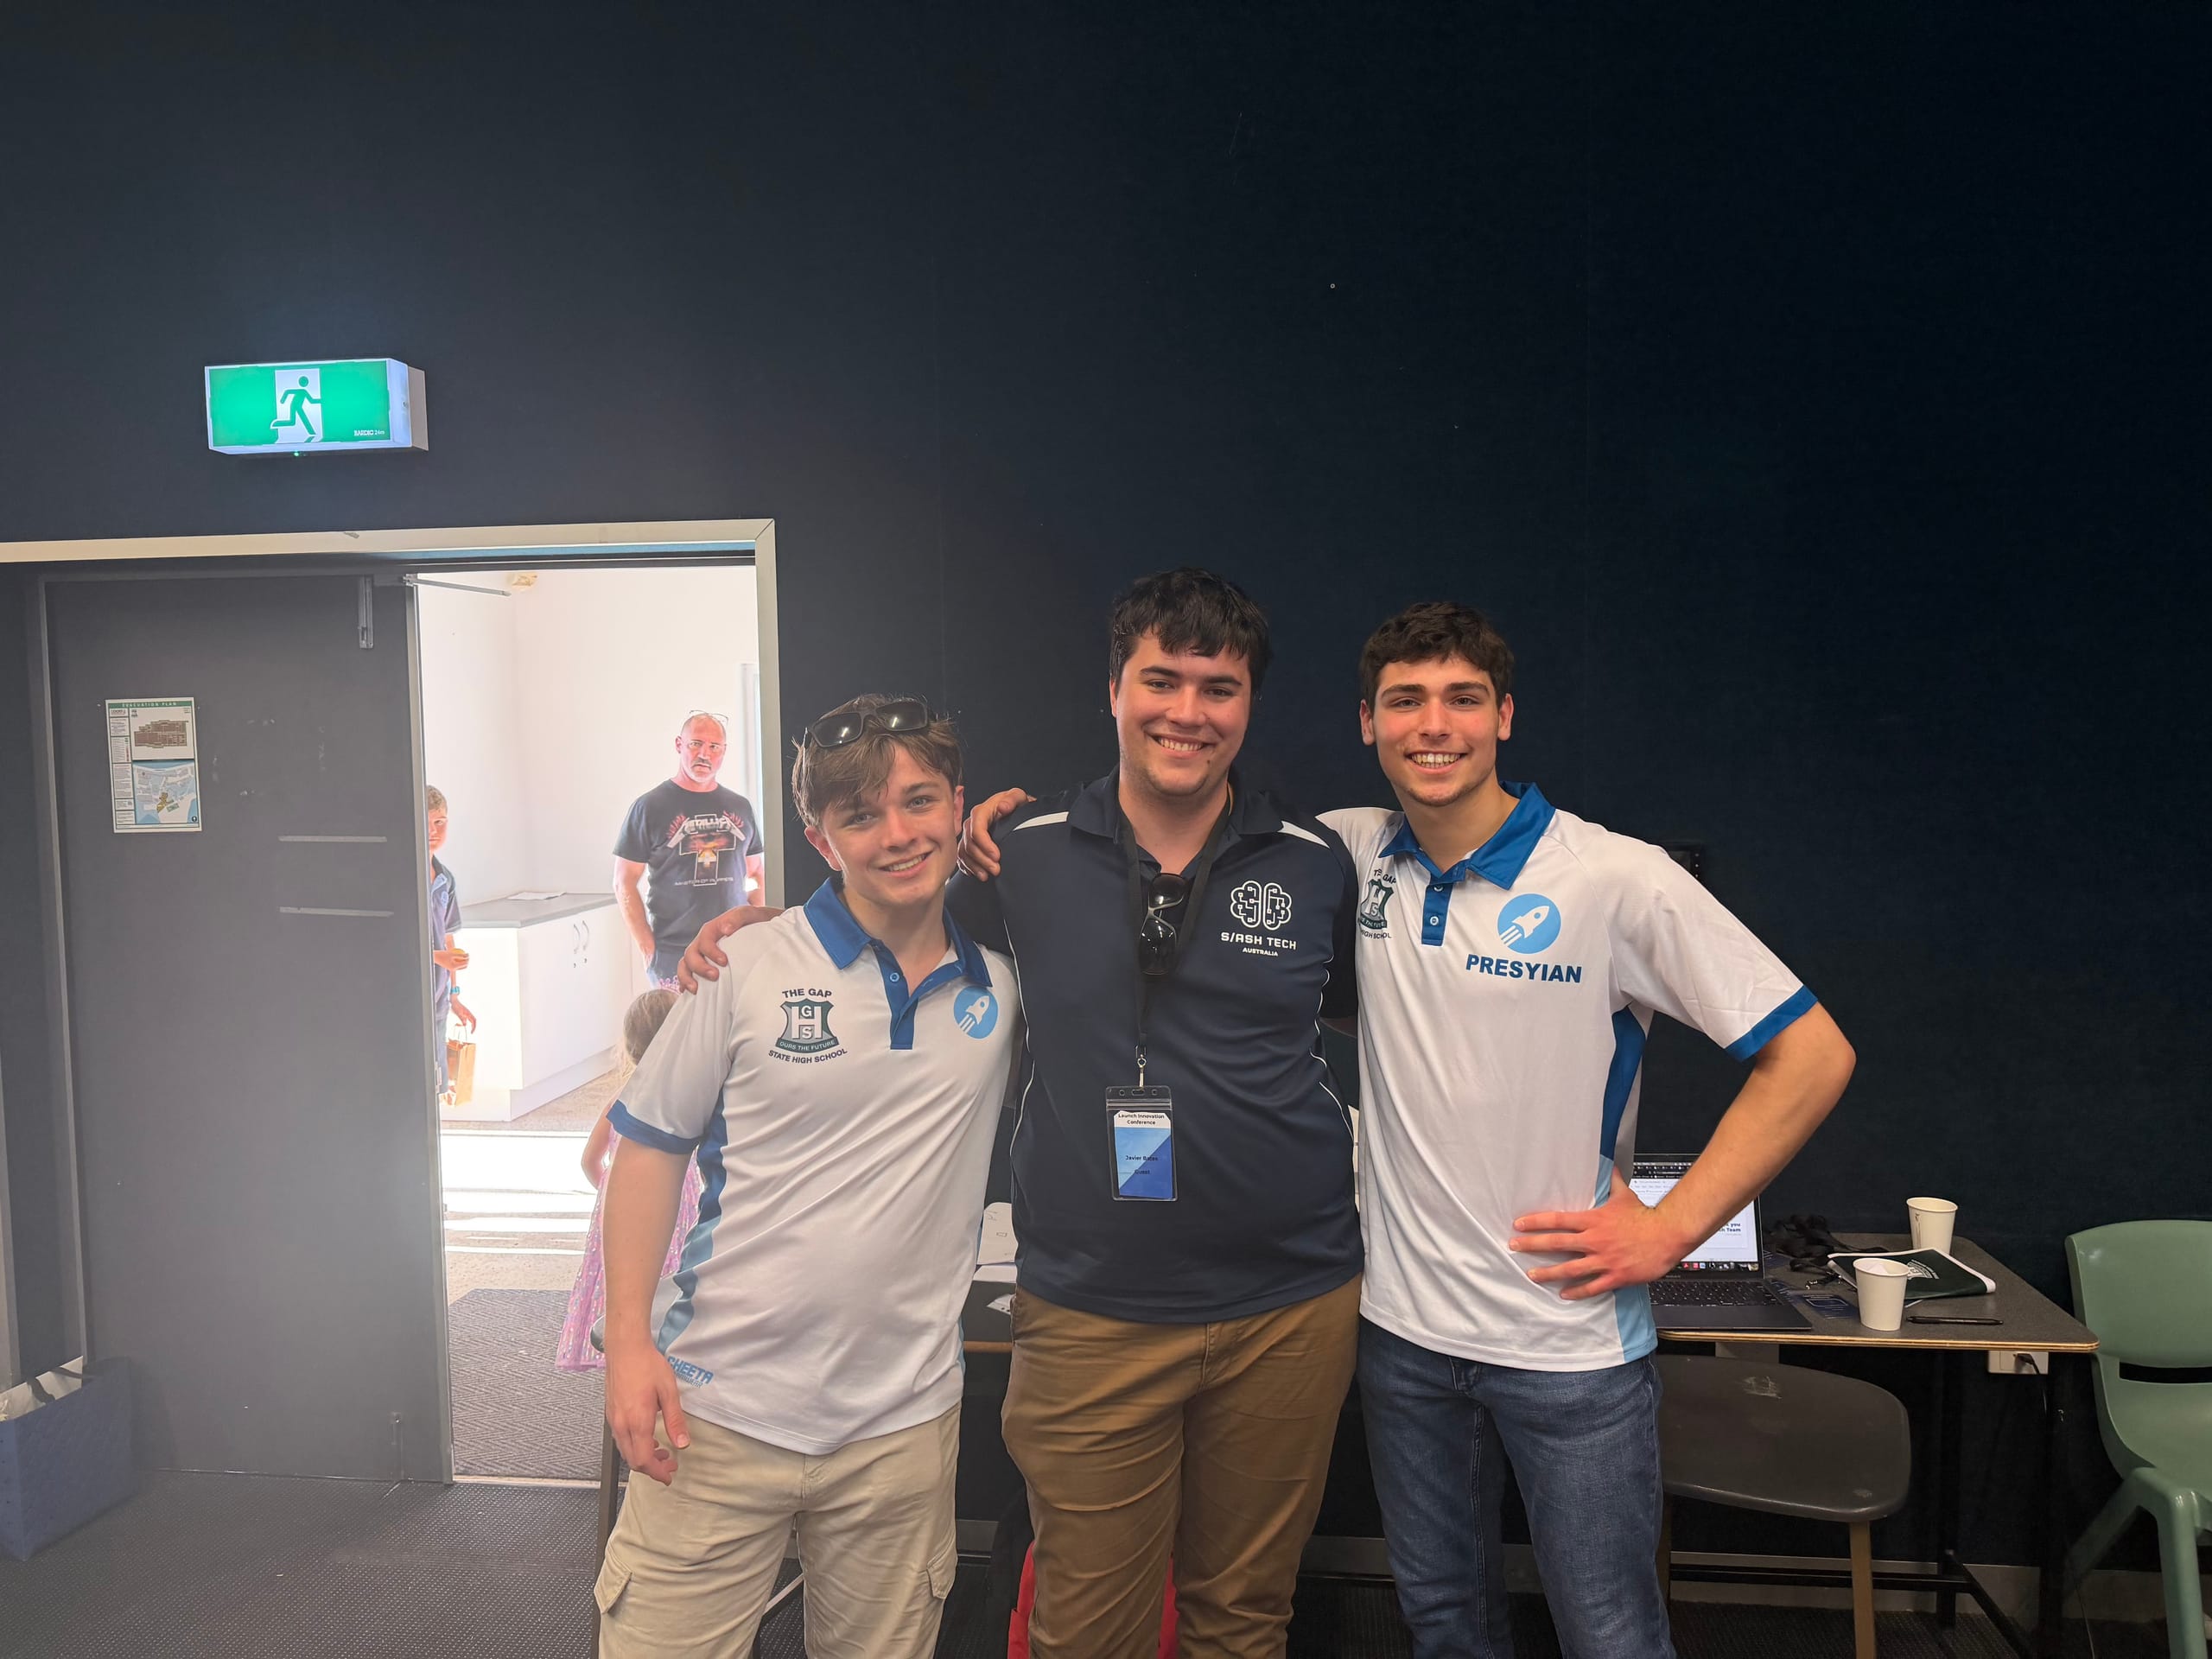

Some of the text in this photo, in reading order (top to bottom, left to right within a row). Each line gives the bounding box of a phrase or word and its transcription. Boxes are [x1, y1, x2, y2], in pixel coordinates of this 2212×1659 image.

[1267, 937, 1296, 950] TECH
[1243, 947, 1278, 957] AUSTRALIA
[1465, 954, 1582, 983] PRESYIAN
[782, 988, 832, 998] THE GAP
[779, 1041, 797, 1050] OURS
[810, 1040, 836, 1051] FUTURE
[768, 1050, 791, 1062] STATE
[814, 1048, 848, 1063] SCHOOL
